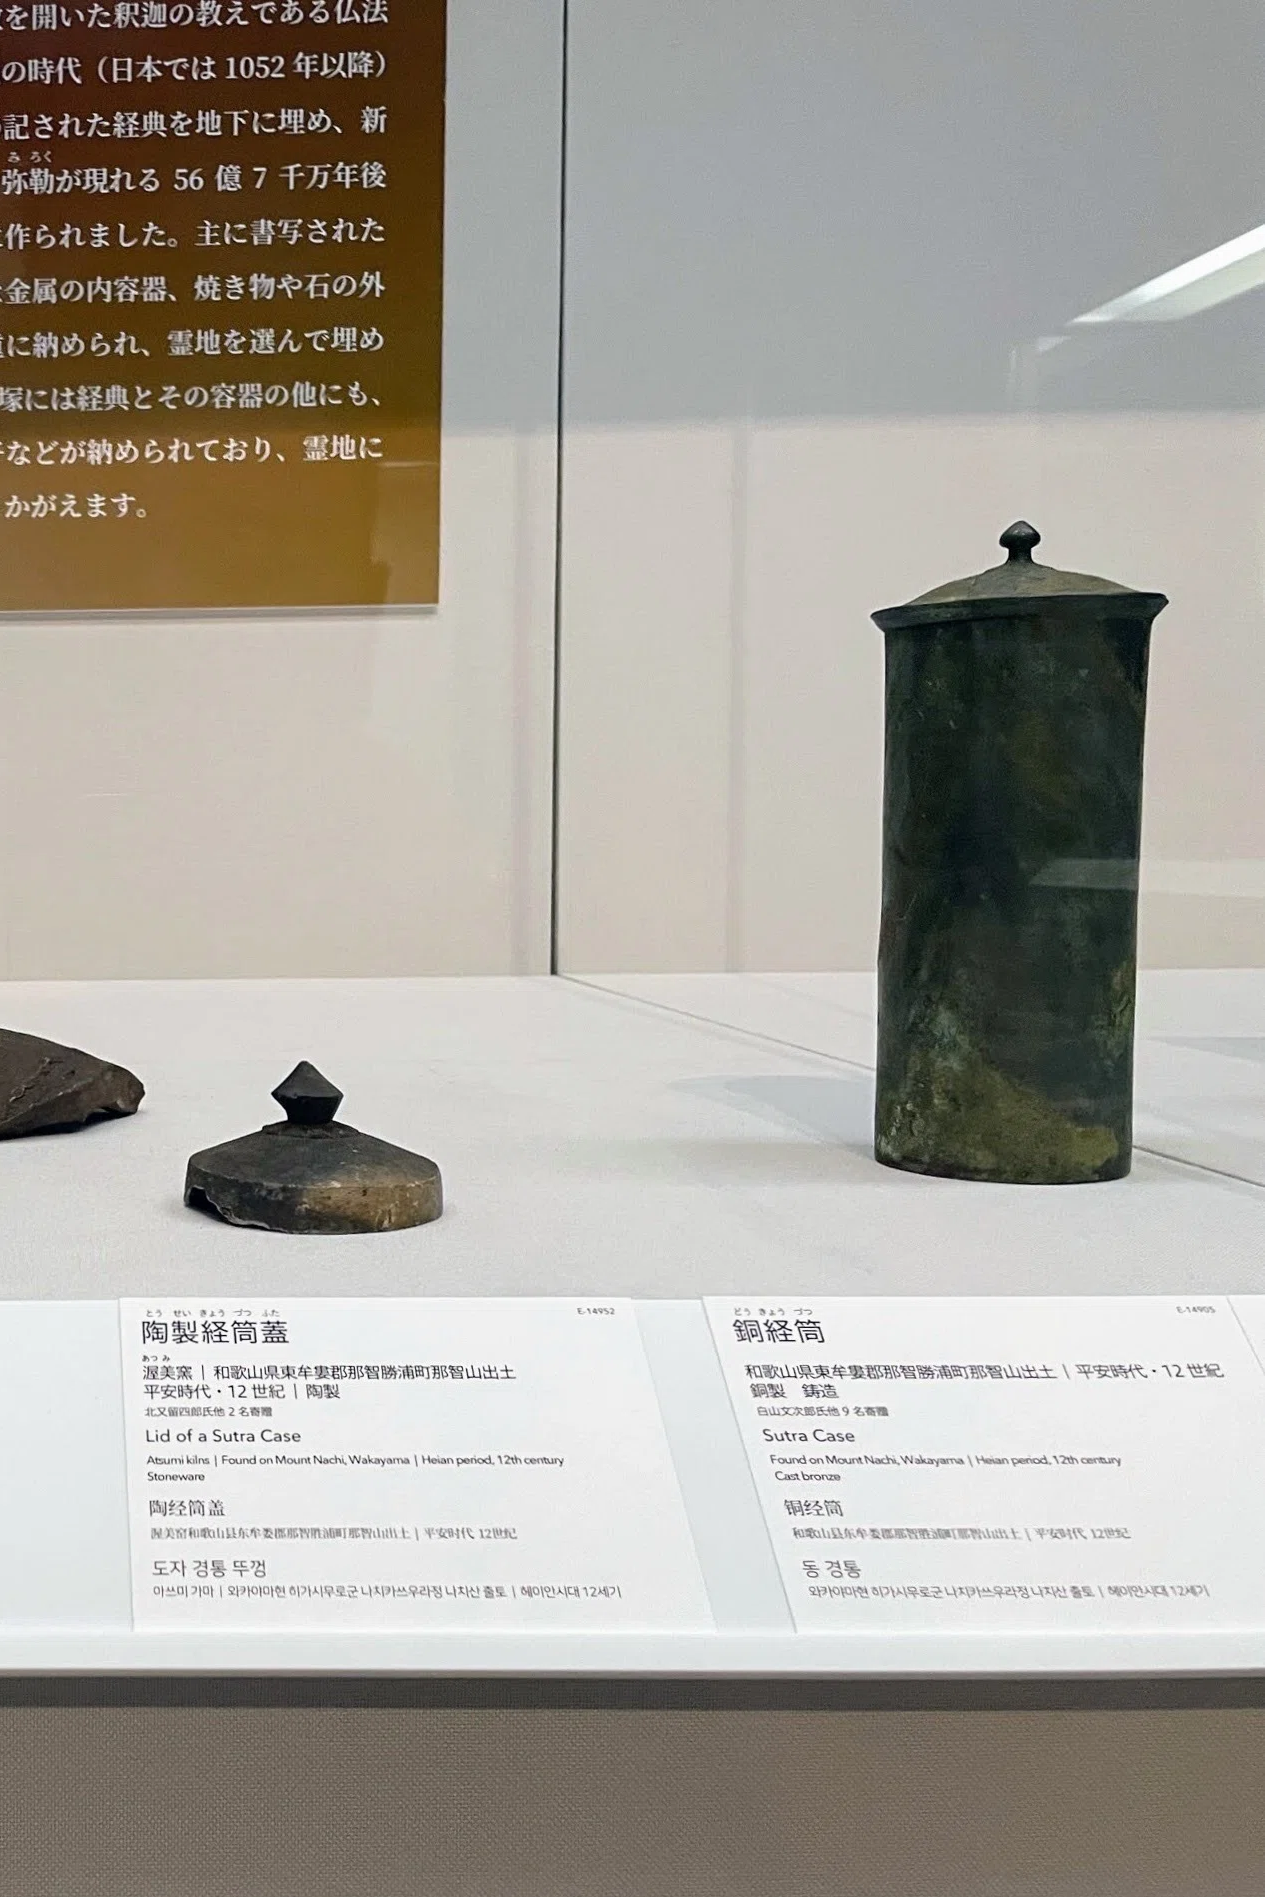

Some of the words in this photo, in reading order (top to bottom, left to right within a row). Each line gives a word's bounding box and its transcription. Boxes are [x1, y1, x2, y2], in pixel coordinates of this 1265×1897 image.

[142, 1320, 289, 1344] 陶製経筒蓋
[733, 1319, 825, 1343] 銅経筒
[306, 1384, 340, 1399] 陶製
[750, 1383, 787, 1398] 銅製
[146, 1429, 170, 1442] Lid
[176, 1429, 192, 1442] of
[199, 1433, 207, 1442] a
[213, 1429, 255, 1442] Sutra
[261, 1429, 301, 1442] Case
[763, 1429, 808, 1442] Sutra
[813, 1429, 855, 1442] Case
[147, 1456, 184, 1465] Atsumi
[186, 1455, 210, 1464] kilns
[222, 1455, 256, 1464] Found
[275, 1455, 311, 1464] Mount
[313, 1455, 347, 1465] Nachi,
[348, 1455, 410, 1467] Wakayama
[422, 1455, 454, 1464] Heian
[456, 1455, 495, 1467] period,
[498, 1455, 522, 1464] 12th
[524, 1457, 564, 1467] century
[770, 1455, 807, 1464] Found
[825, 1455, 863, 1464] Mount
[864, 1455, 899, 1465] Nachi,
[900, 1455, 965, 1467] Wakayama
[975, 1456, 1009, 1464] Heian
[1053, 1455, 1079, 1464] 12th
[1081, 1457, 1121, 1467] century
[148, 1472, 205, 1481] Stoneware
[775, 1471, 800, 1481] Cast
[801, 1471, 840, 1481] bronze
[153, 1560, 186, 1577] 도자
[193, 1560, 227, 1578] 경통
[803, 1560, 820, 1578] 동
[825, 1560, 861, 1578] 경통
